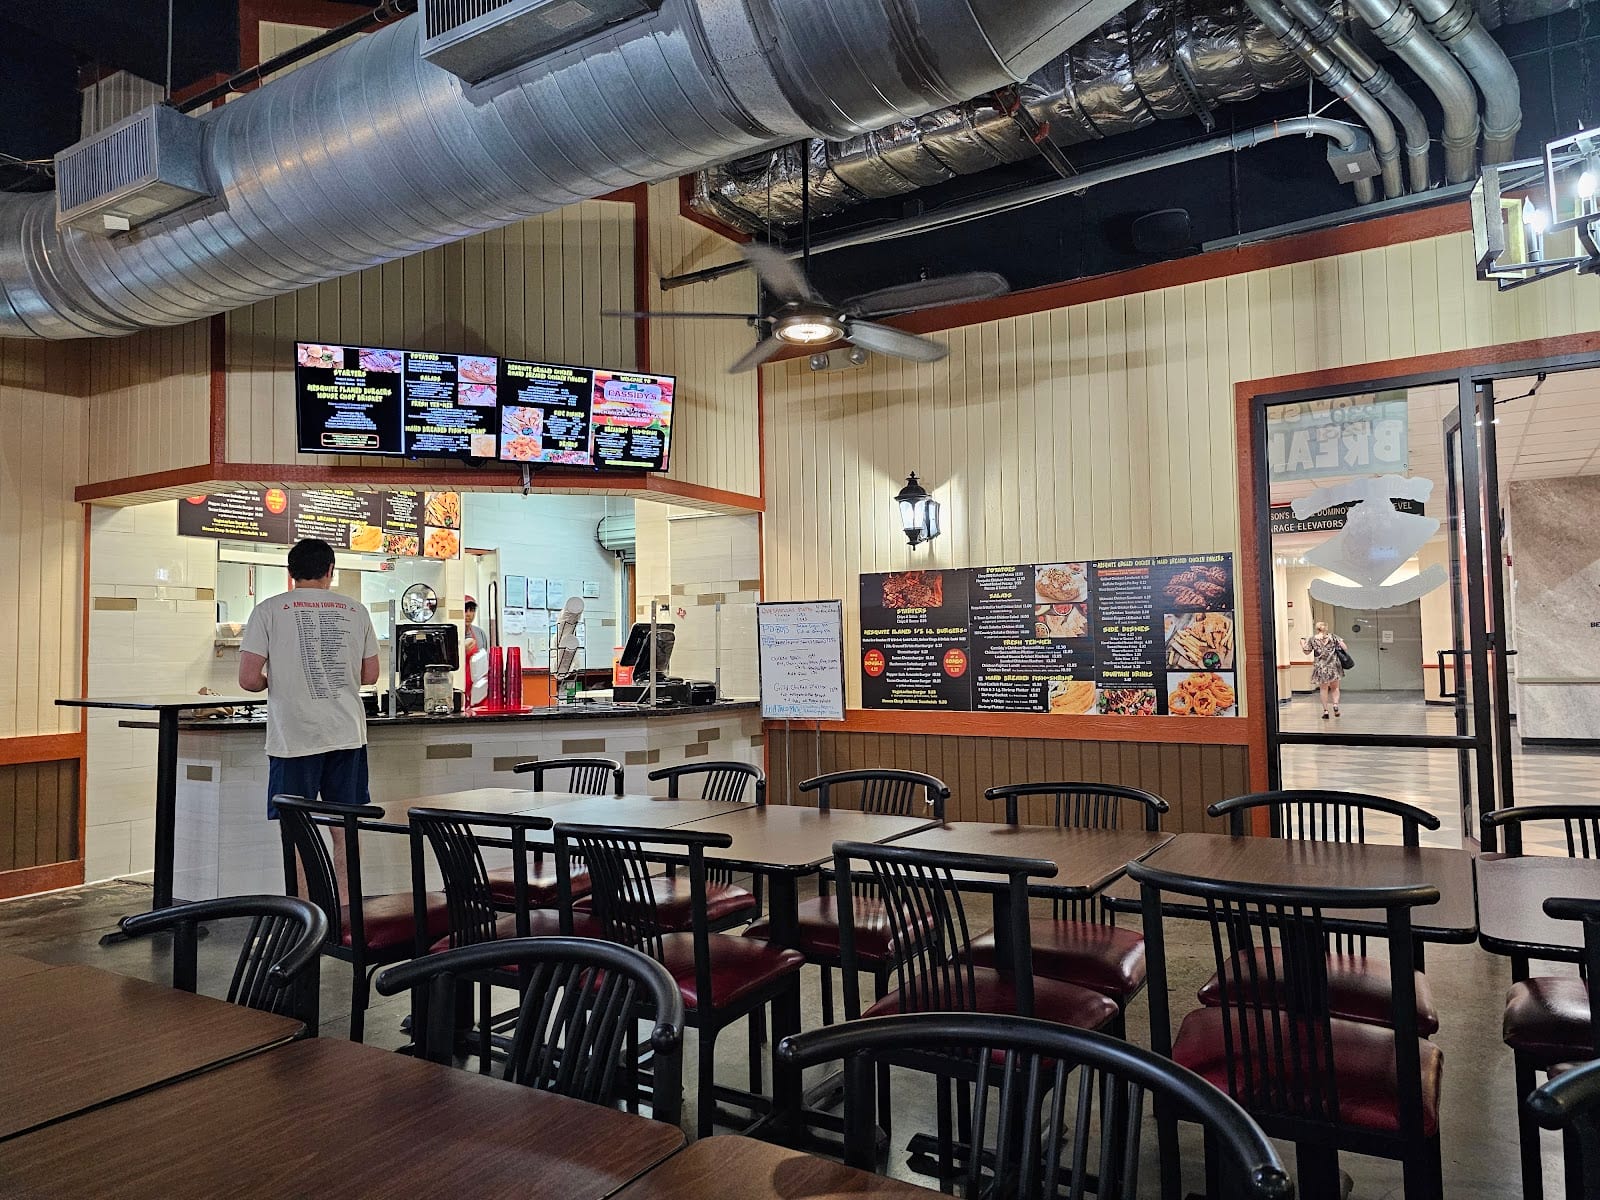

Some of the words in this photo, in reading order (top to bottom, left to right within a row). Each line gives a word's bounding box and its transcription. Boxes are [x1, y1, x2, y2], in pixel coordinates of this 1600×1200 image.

[608, 389, 657, 400] CASSIDY'S
[1270, 522, 1295, 533] RAGE
[1297, 519, 1344, 531] ELEVATORS
[1102, 670, 1130, 678] FOUNTAIN
[1131, 670, 1153, 678] DRINKS
